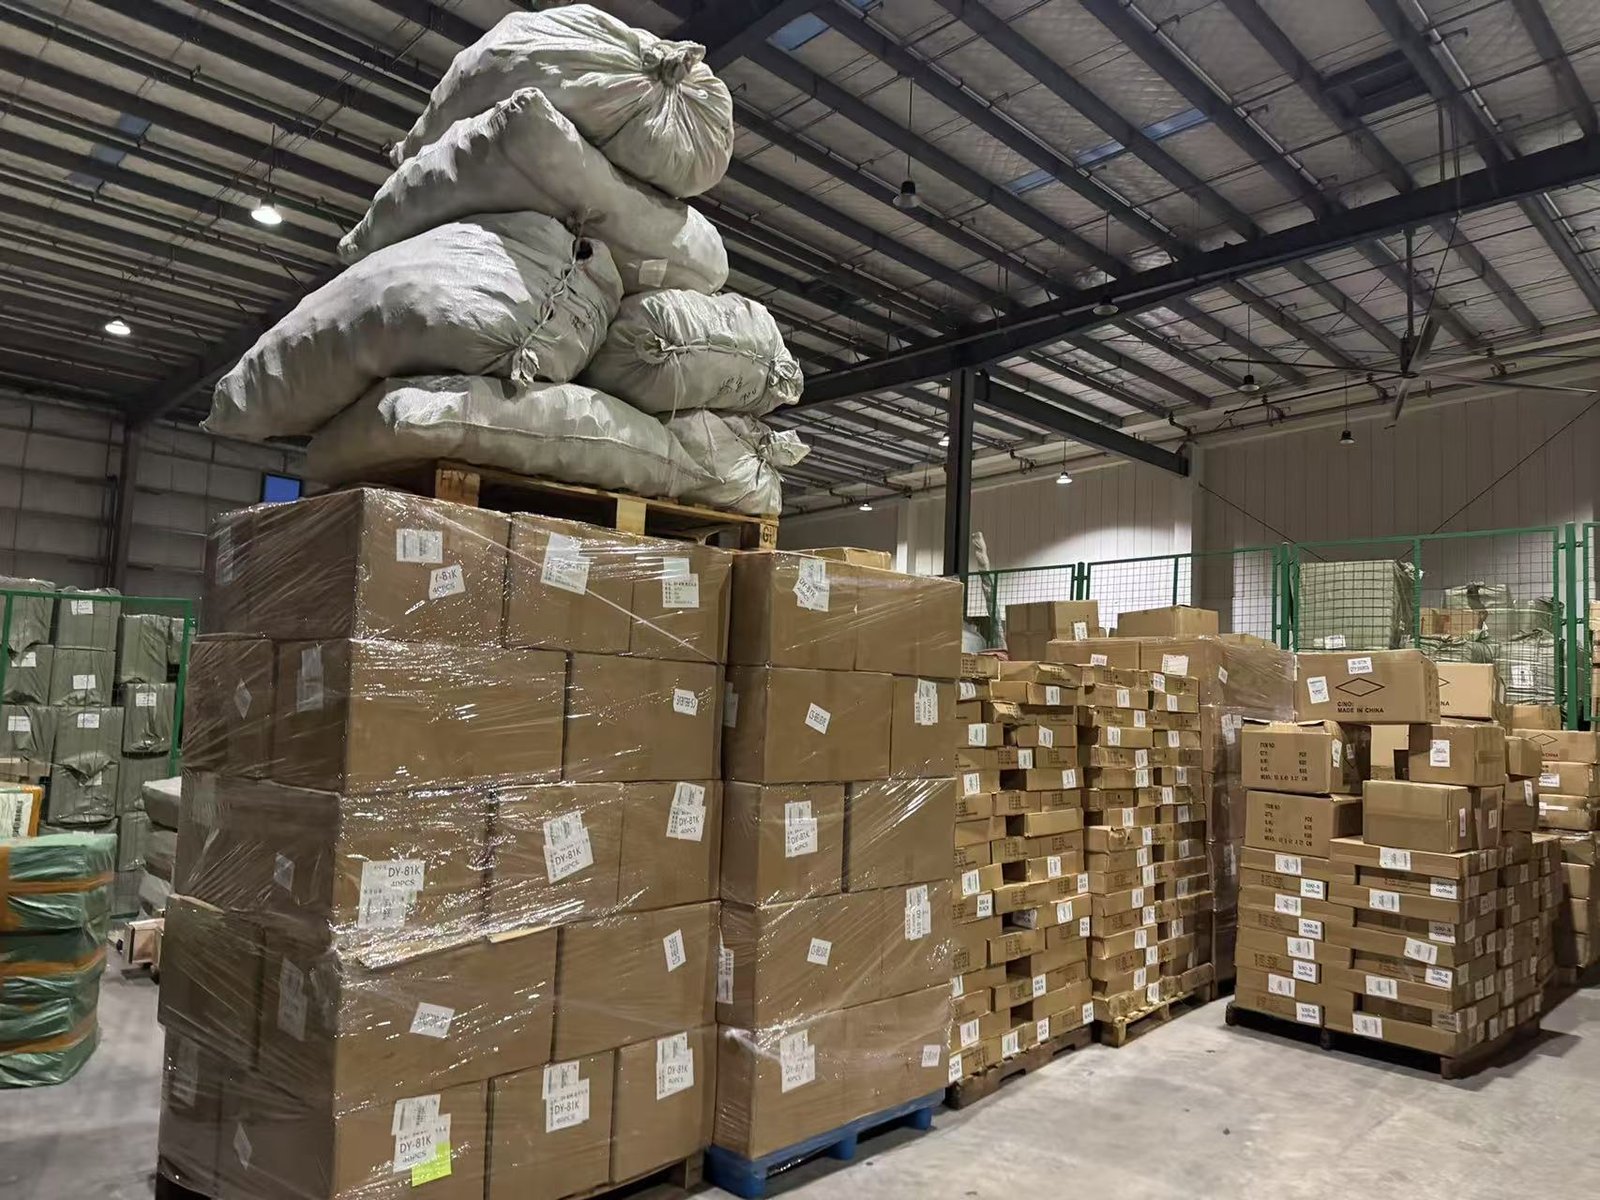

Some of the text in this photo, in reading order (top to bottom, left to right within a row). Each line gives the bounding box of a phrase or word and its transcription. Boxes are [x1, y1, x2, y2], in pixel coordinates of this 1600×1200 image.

[555, 847, 582, 865] DY-81K
[388, 865, 421, 878] DY-81K
[667, 1064, 689, 1075] DY-81K
[555, 1099, 580, 1115] DY-81K
[400, 1136, 432, 1154] DY-81K
